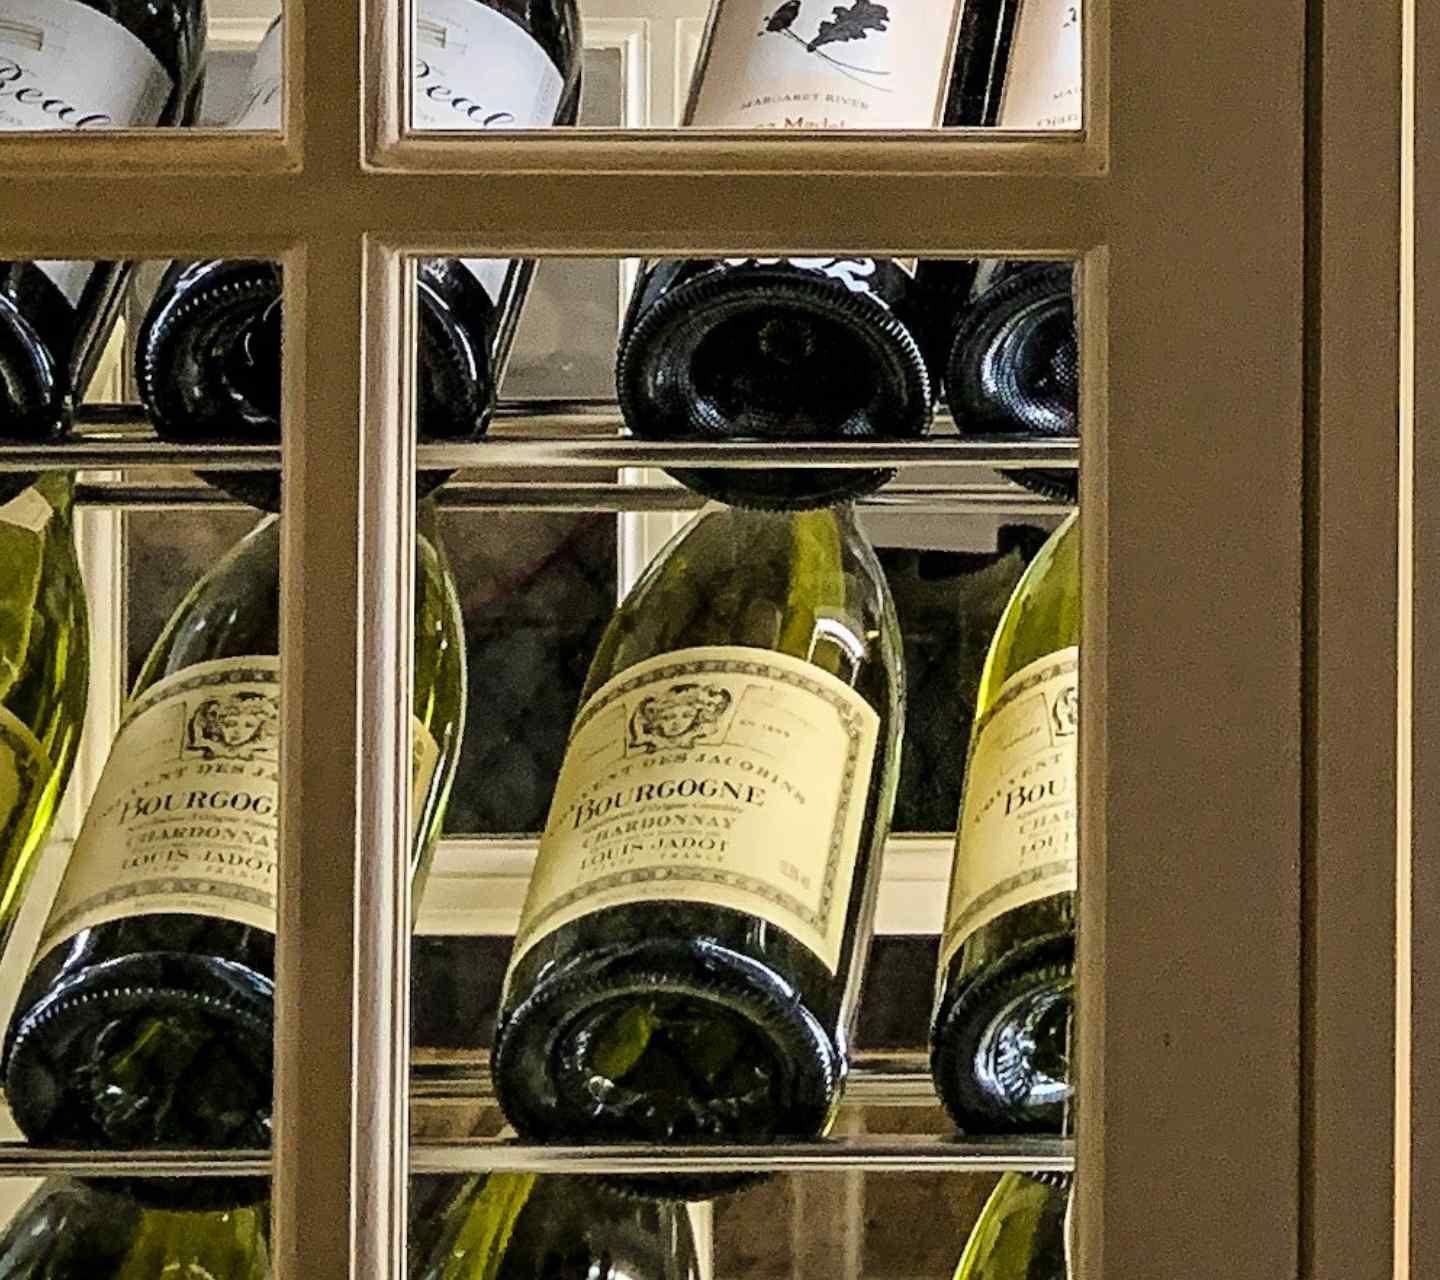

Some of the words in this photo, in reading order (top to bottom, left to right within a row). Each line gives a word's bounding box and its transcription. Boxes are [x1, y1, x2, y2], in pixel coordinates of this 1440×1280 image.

[740, 93, 820, 111] MARGARET
[824, 93, 870, 110] RIVER
[197, 762, 245, 776] DES
[642, 751, 688, 768] DES
[694, 752, 807, 806] JACOBINS
[573, 778, 767, 829] BOURGOGNE
[581, 812, 737, 849] CHARDONNAY
[580, 842, 644, 871] LOUIS
[651, 836, 727, 854] JADOT
